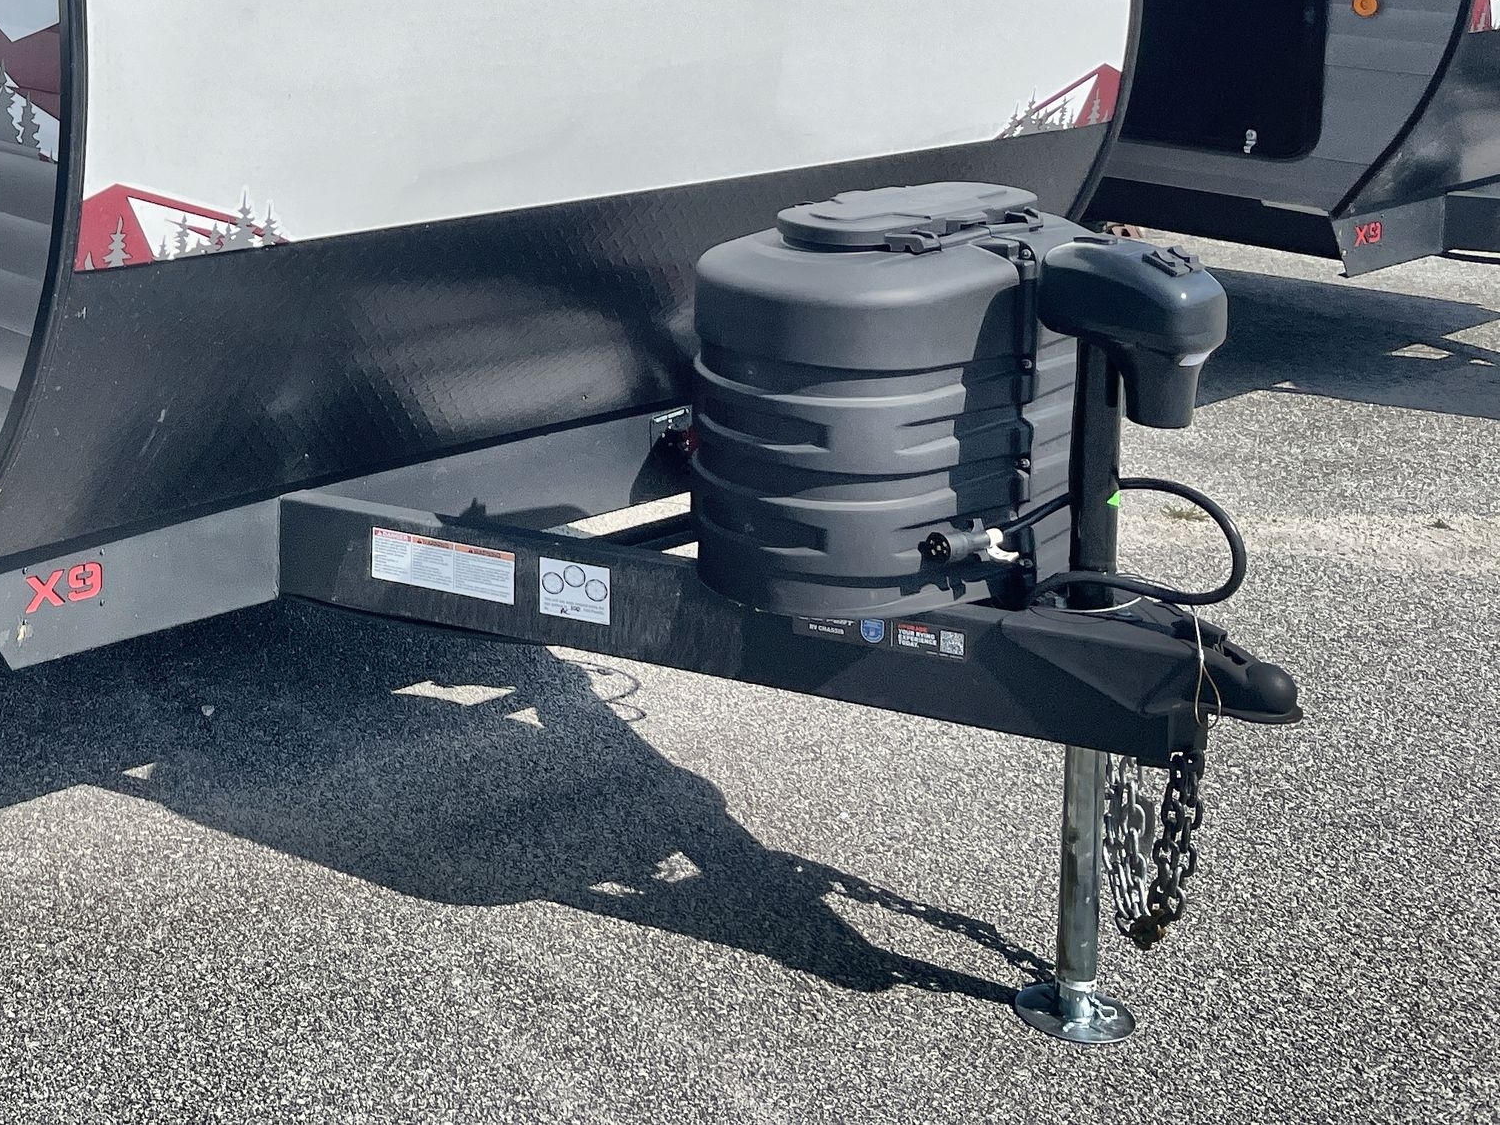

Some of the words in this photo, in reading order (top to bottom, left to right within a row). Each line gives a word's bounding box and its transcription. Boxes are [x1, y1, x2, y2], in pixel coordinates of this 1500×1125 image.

[1353, 221, 1383, 248] X9
[25, 562, 103, 614] X9
[898, 633, 937, 646] EXPERIENCE
